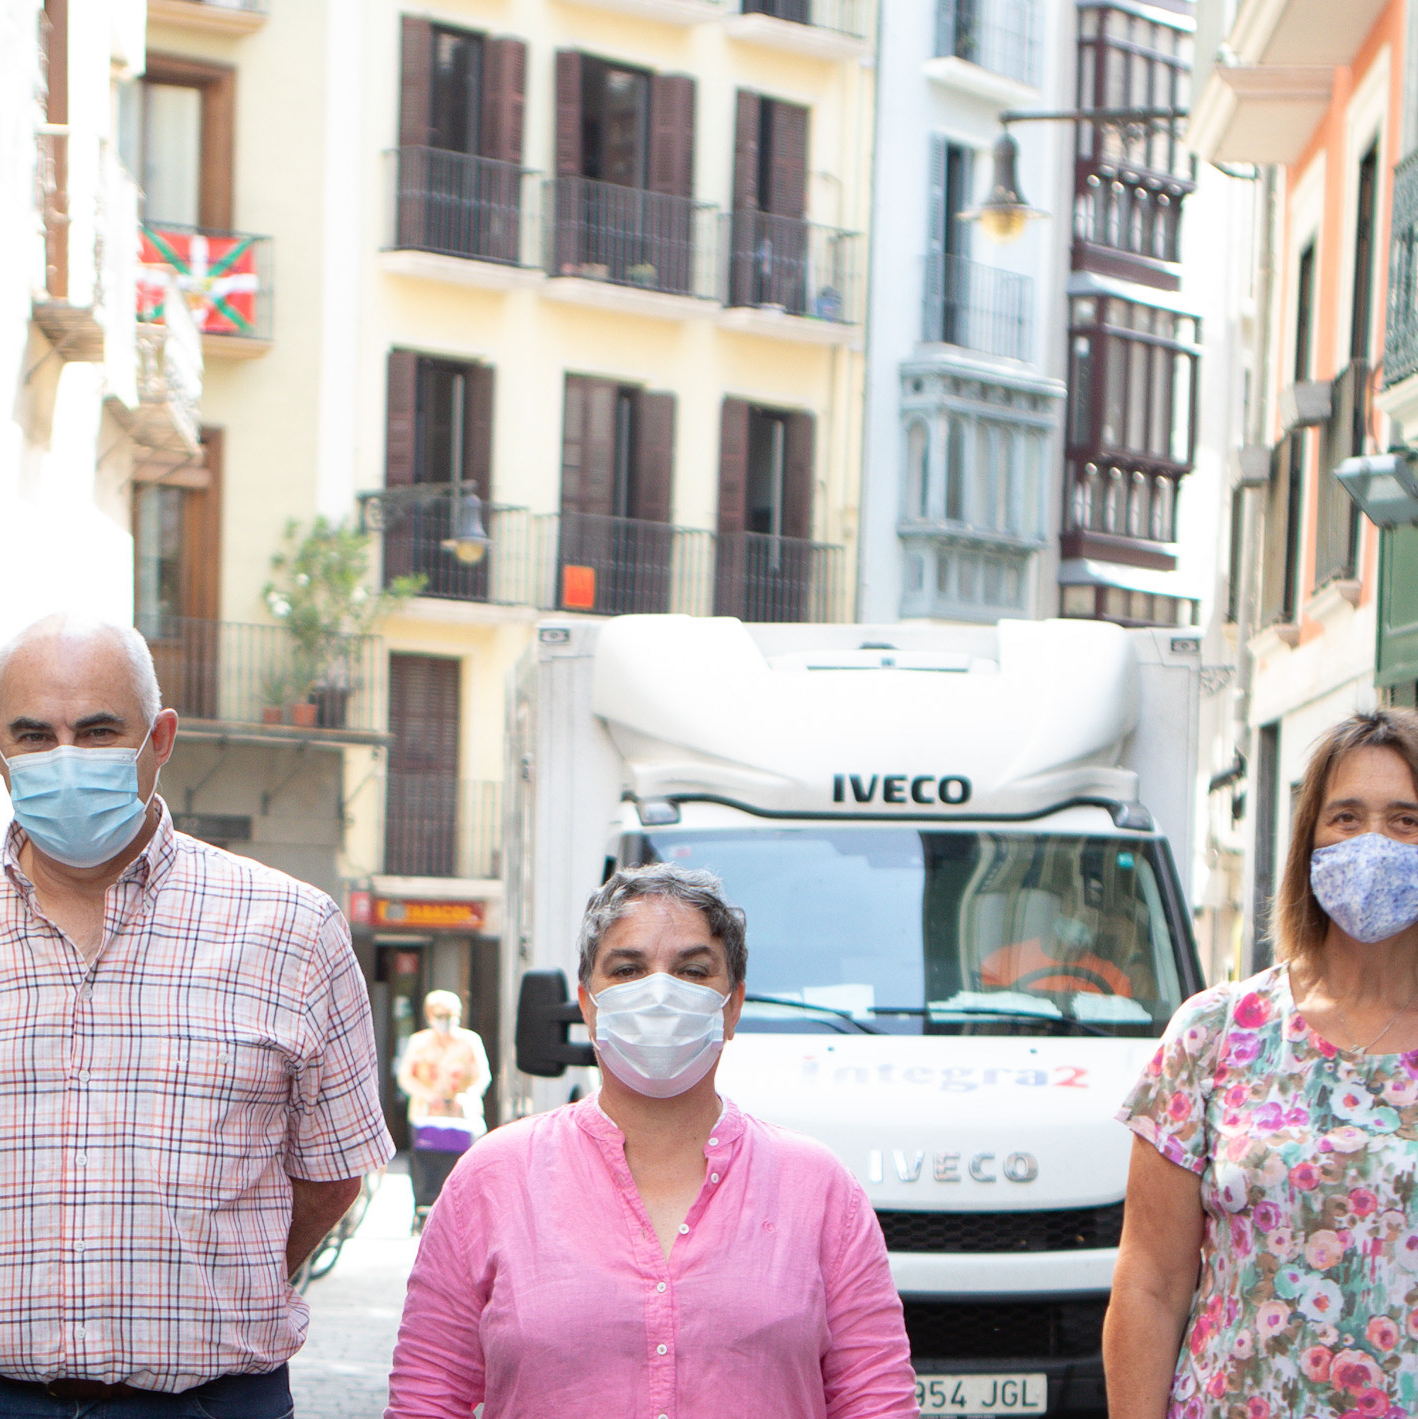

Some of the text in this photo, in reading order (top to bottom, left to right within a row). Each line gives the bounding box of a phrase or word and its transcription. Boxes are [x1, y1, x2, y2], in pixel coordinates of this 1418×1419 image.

[833, 773, 973, 805] IVECO
[869, 1149, 1039, 1183] IVECO
[981, 1379, 1039, 1408] JGL
